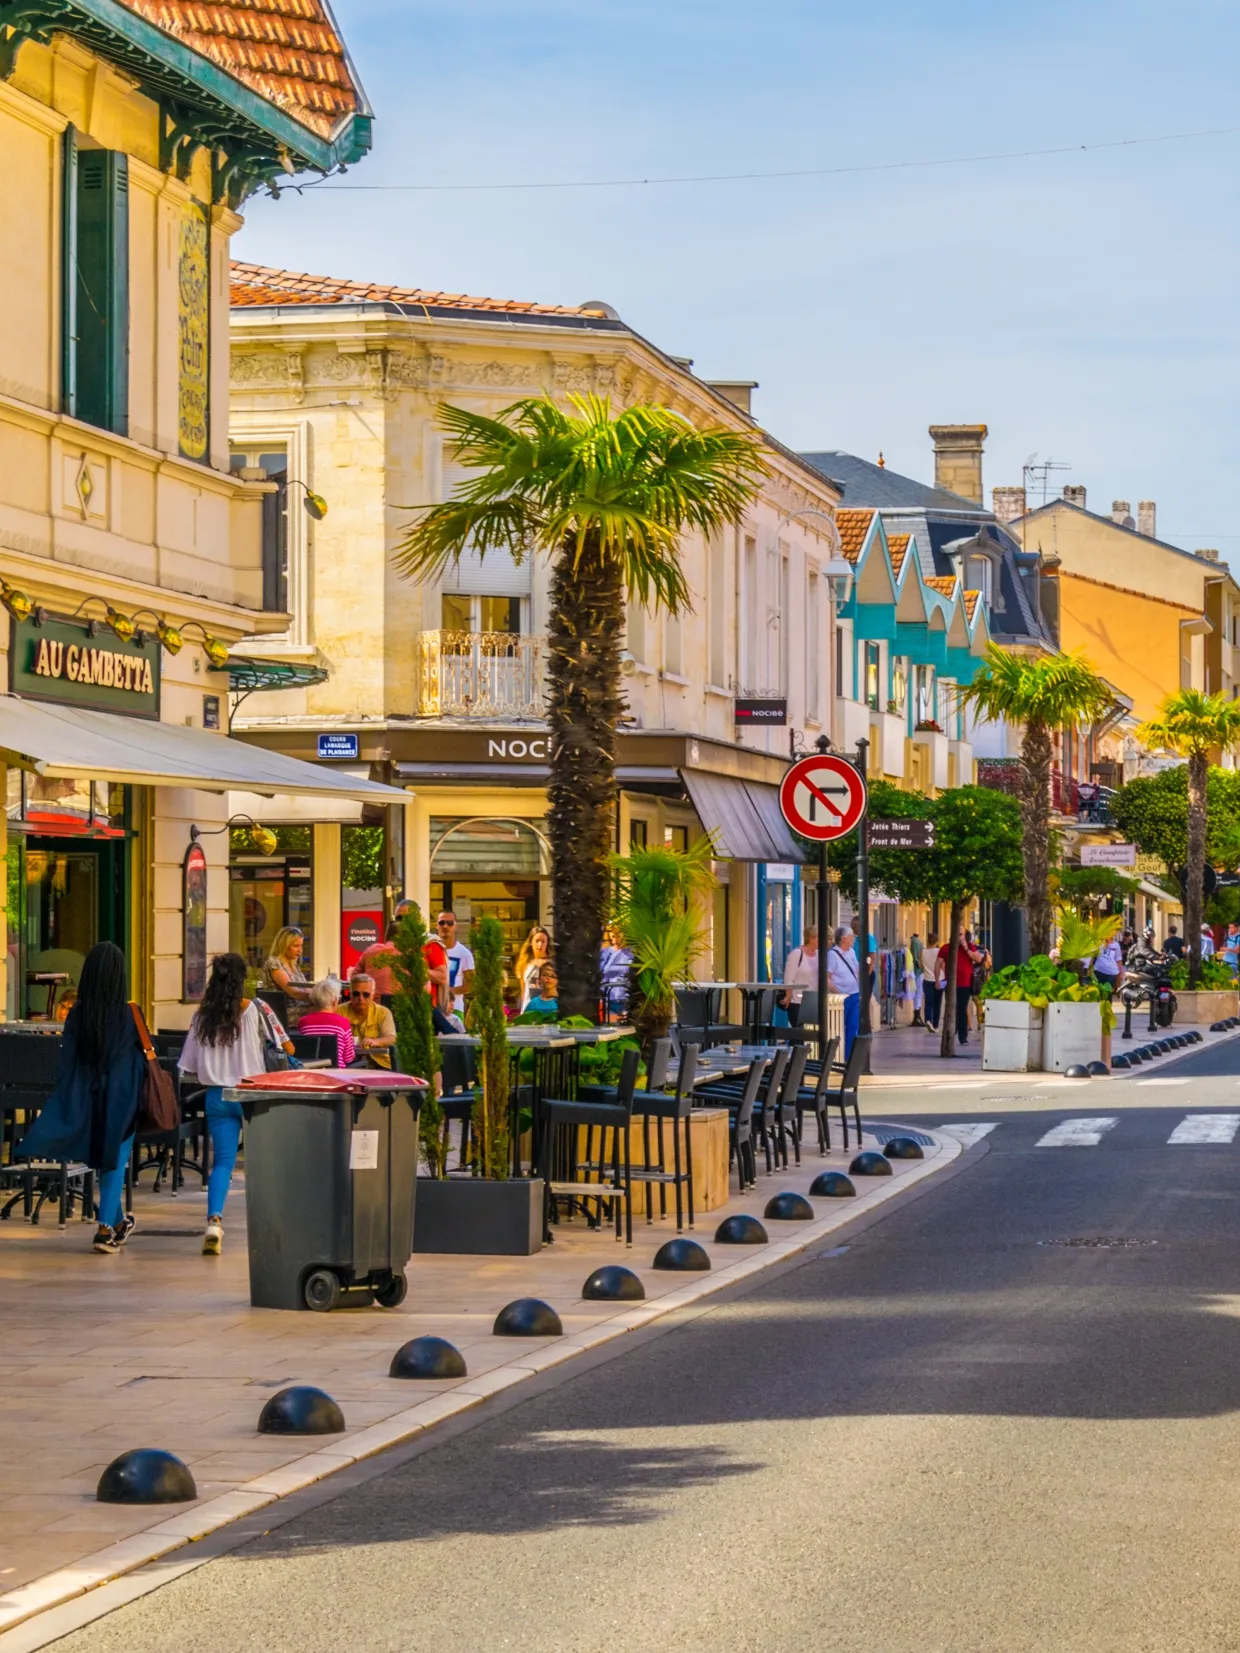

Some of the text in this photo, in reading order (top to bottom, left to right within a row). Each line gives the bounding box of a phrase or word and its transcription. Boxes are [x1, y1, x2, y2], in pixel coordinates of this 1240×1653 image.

[36, 638, 154, 694] AU GAMBETTA
[488, 737, 553, 758] NOCI
[871, 822, 911, 831] Jetée Thiers
[871, 837, 912, 846] Front de Mer
